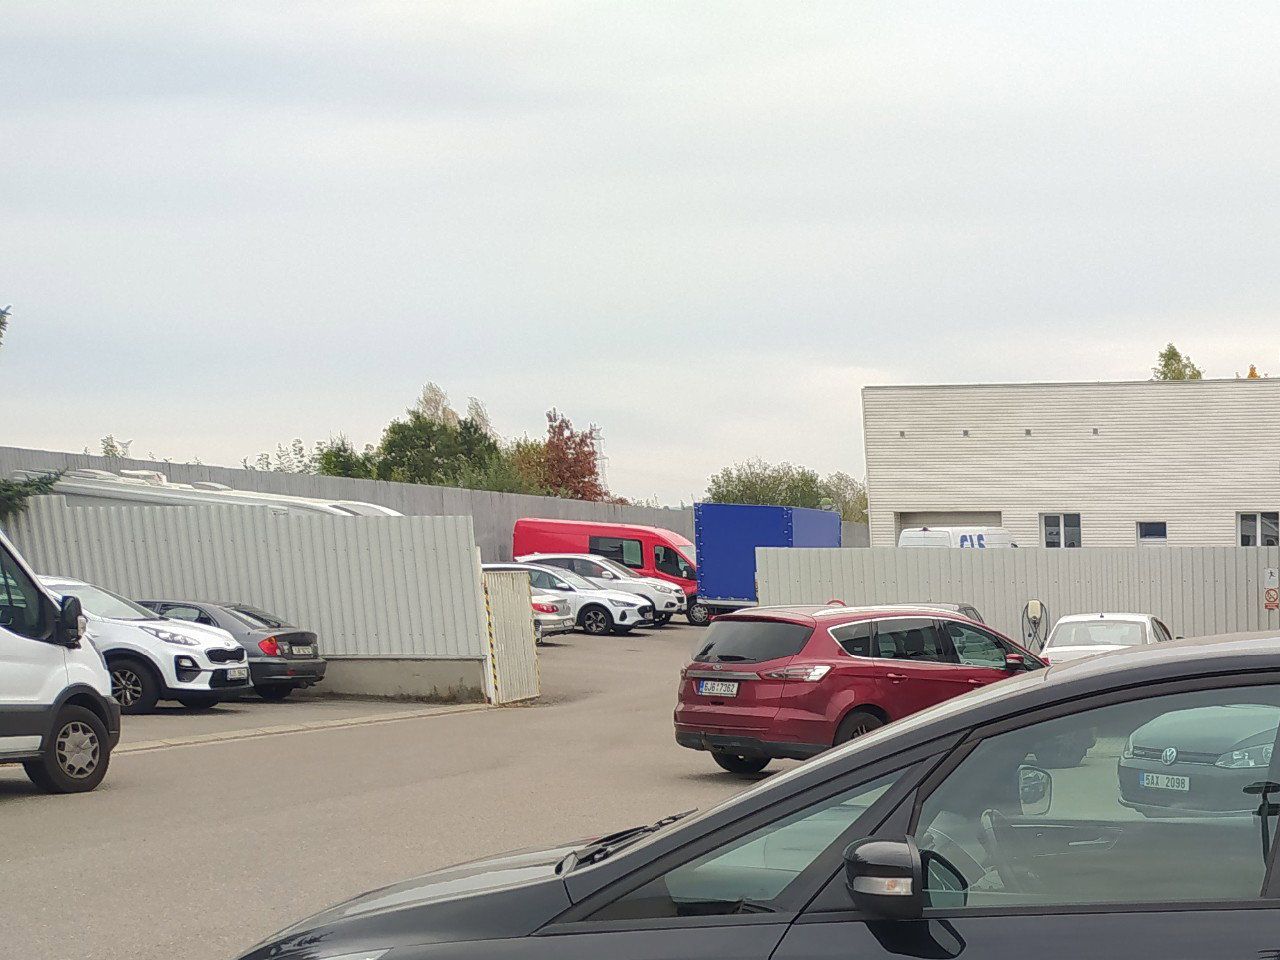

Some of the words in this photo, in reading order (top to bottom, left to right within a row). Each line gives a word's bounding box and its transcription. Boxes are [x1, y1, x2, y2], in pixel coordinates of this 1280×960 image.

[719, 683, 735, 693] 7362
[1145, 774, 1160, 787] 5AX
[1165, 775, 1186, 789] 2098
